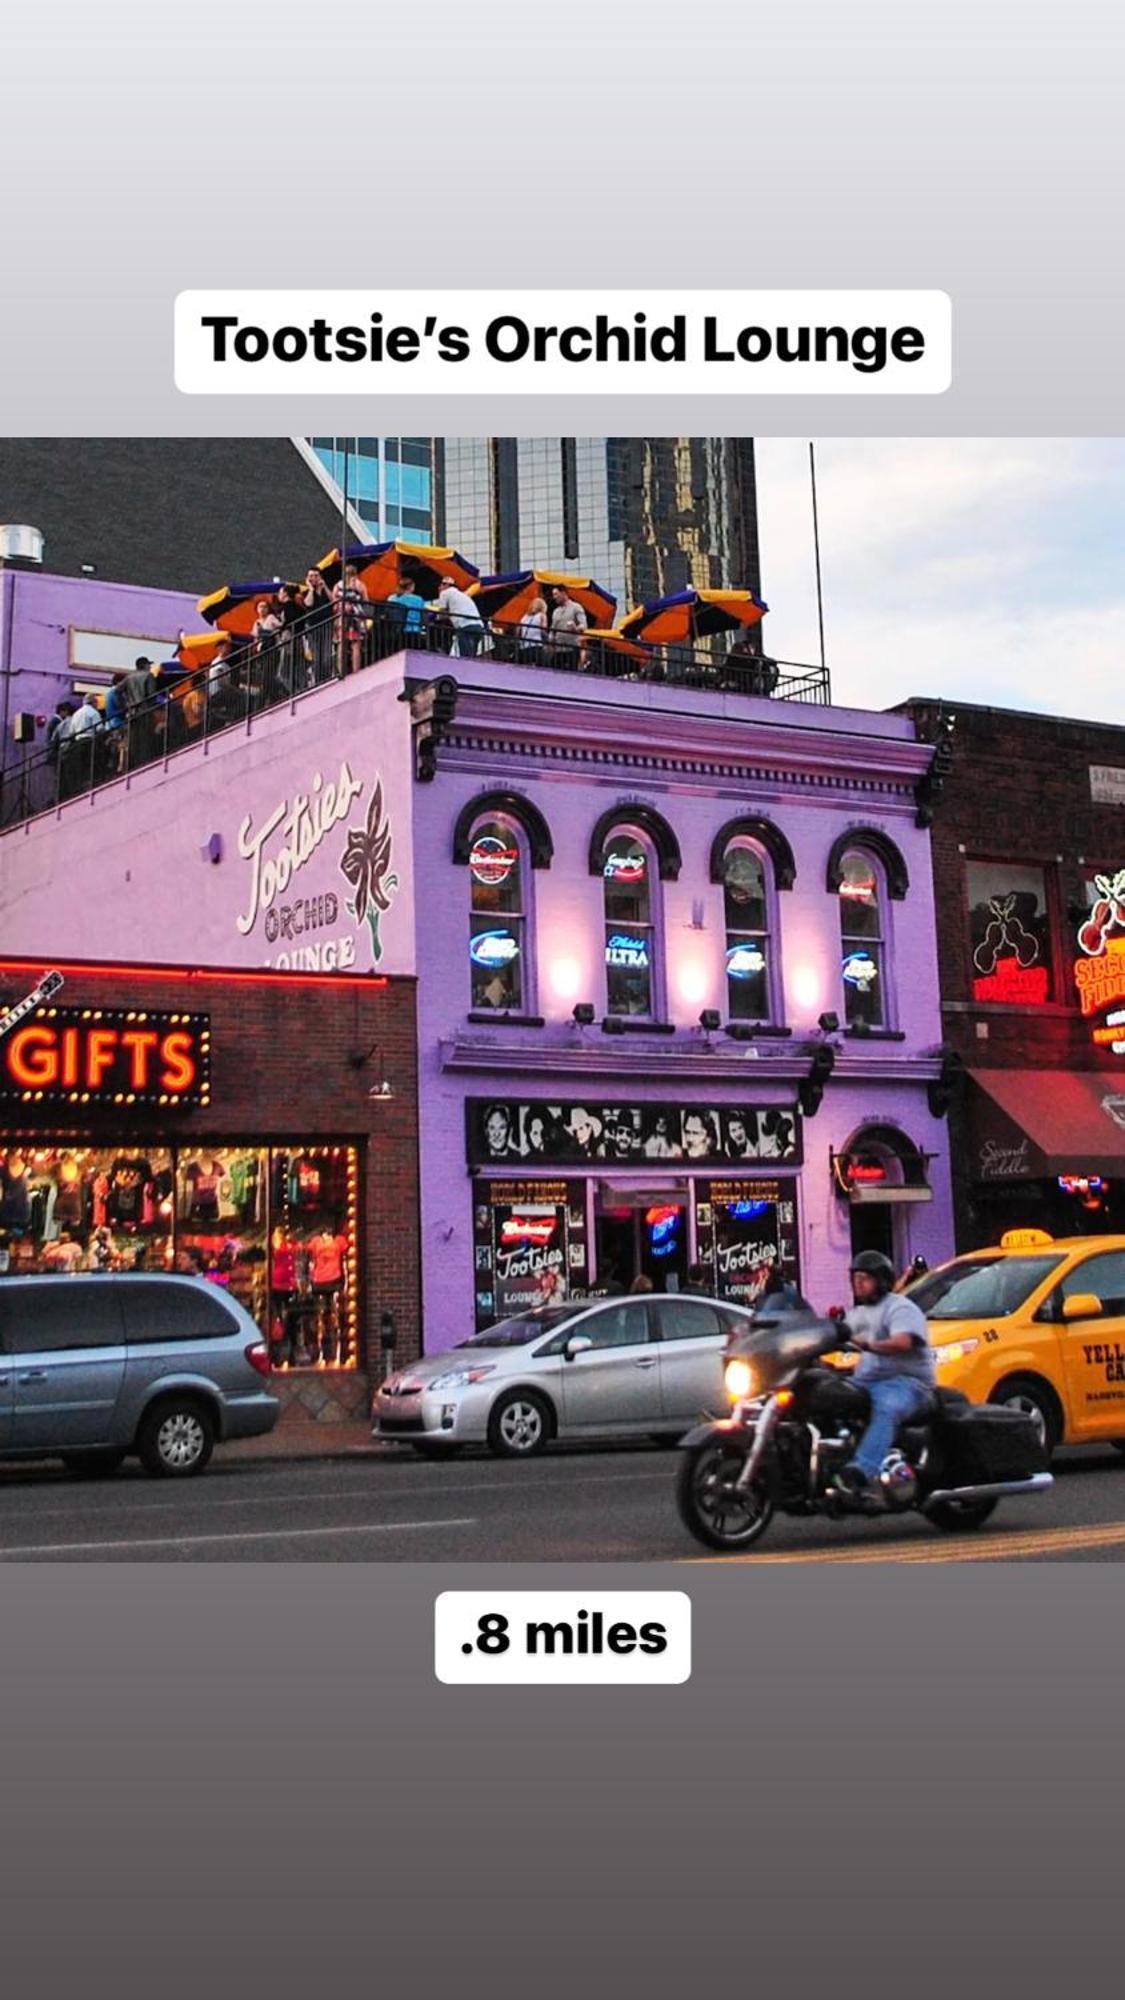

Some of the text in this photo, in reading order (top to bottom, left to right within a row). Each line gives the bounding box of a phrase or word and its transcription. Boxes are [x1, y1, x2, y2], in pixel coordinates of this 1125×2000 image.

[237, 762, 363, 935] Tootsies
[264, 892, 338, 943] ORCHID
[265, 936, 354, 971] OUNGE
[9, 1025, 195, 1090] GIFTS
[497, 1246, 563, 1280] Tootsies
[717, 1242, 777, 1272] Tootsies
